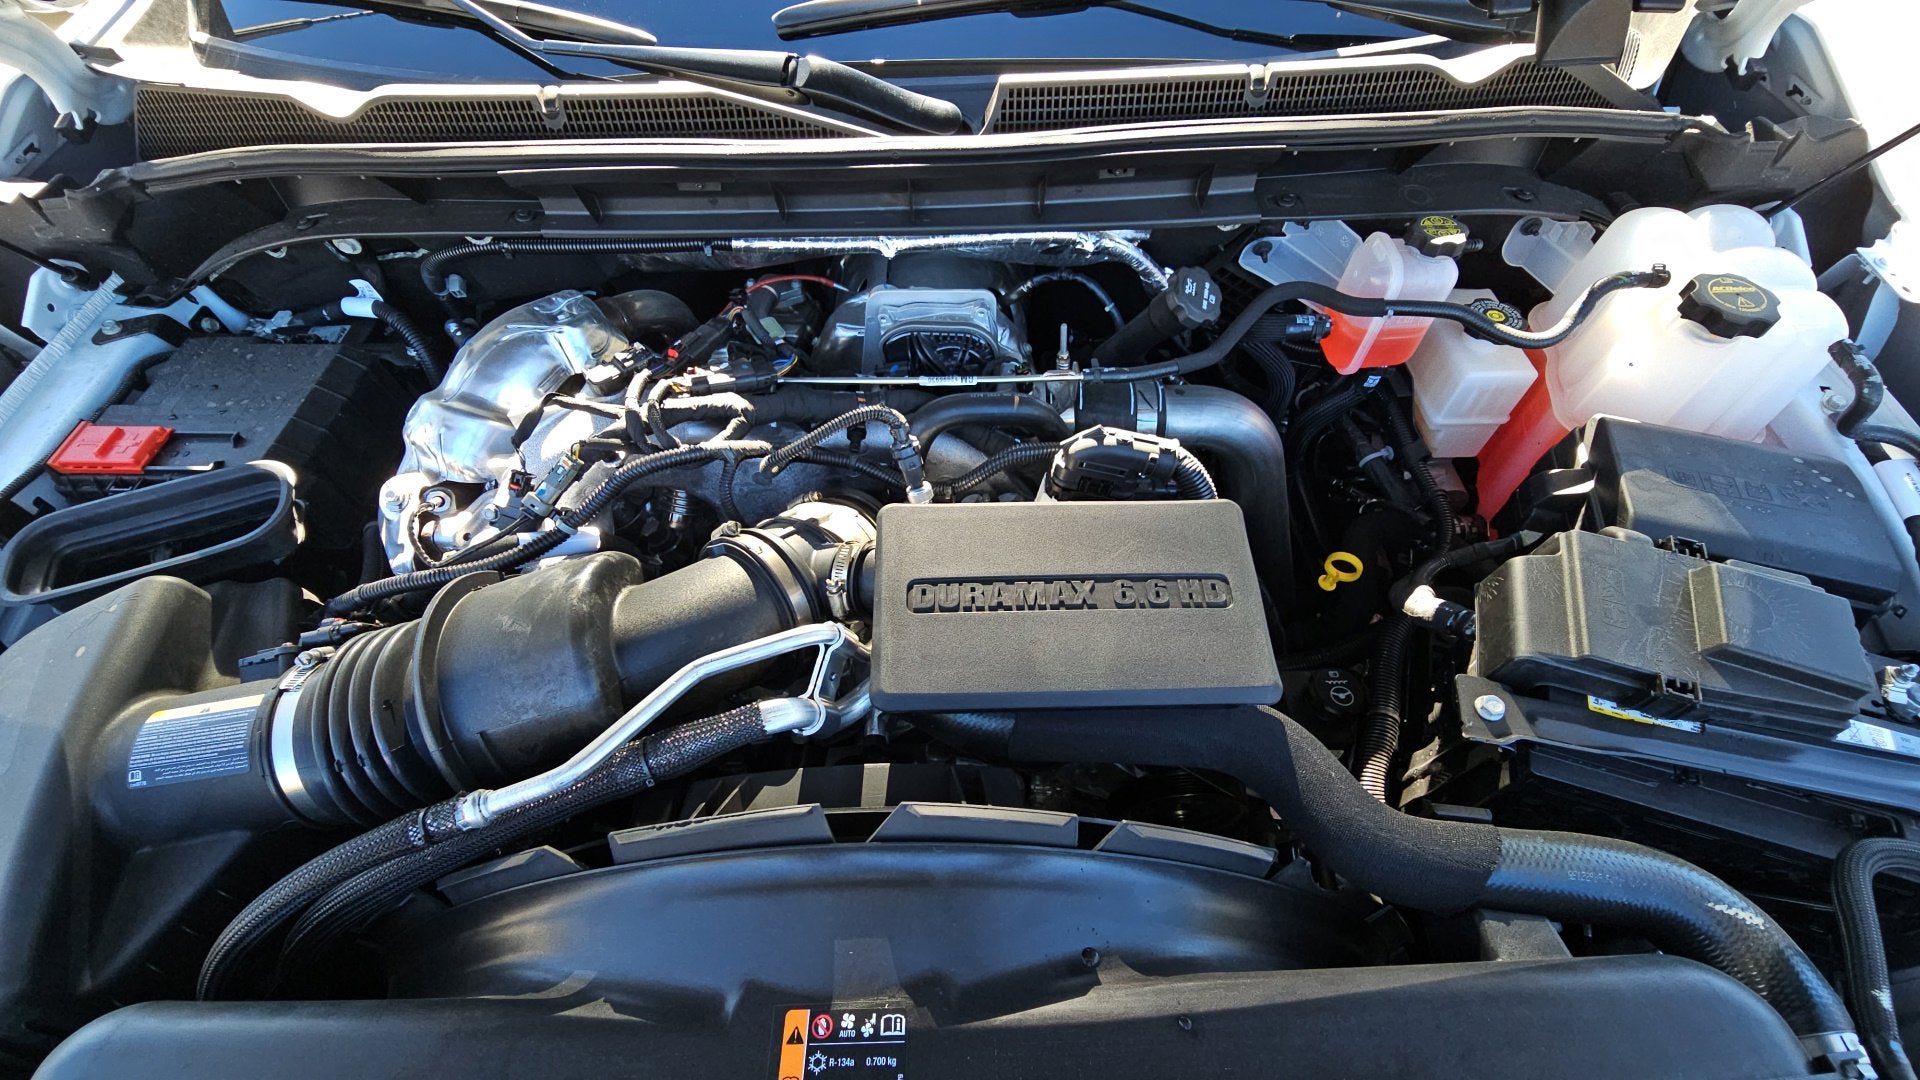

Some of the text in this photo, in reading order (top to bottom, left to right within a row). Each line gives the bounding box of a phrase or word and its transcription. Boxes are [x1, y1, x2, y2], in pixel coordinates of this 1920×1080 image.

[912, 578, 1227, 610] DURAMAX 6.6 HD
[829, 1056, 897, 1067] R-134a 0.700 kg
